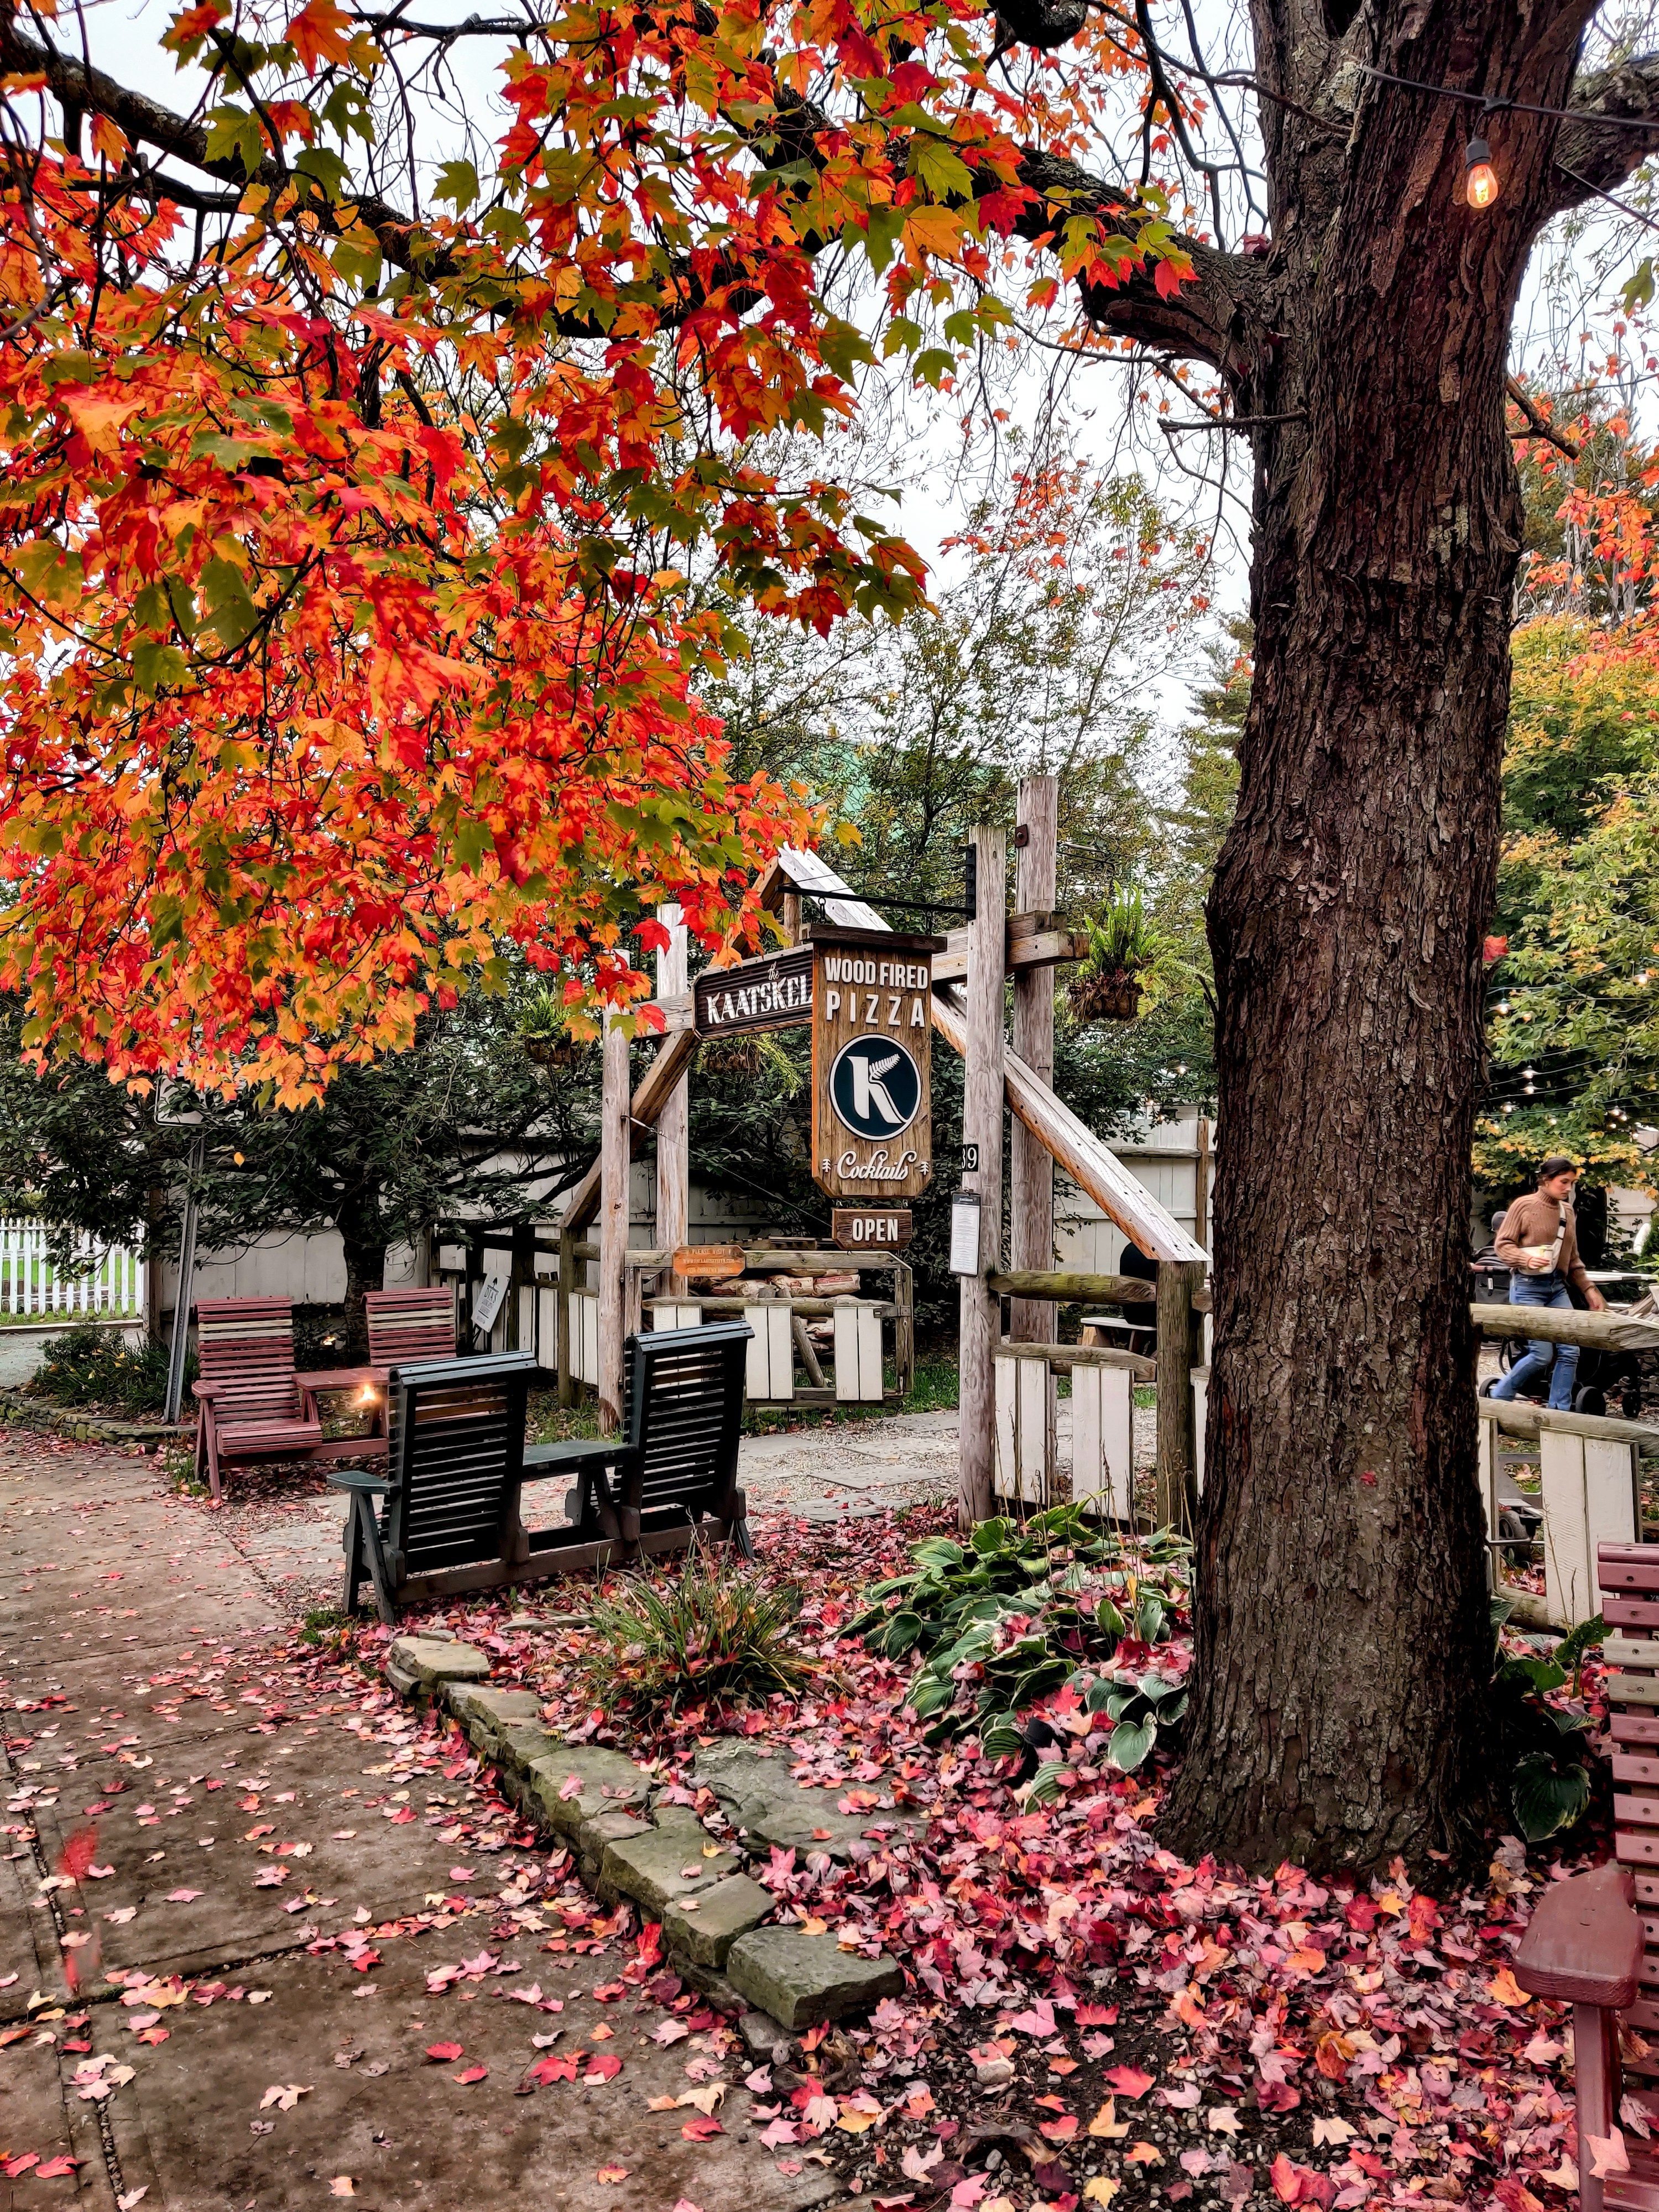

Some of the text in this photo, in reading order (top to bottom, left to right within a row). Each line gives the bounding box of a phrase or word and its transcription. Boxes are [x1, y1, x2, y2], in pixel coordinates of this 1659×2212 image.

[768, 961, 780, 980] the
[825, 957, 928, 989] WOOD FIRED
[826, 990, 925, 1027] PIZZA
[846, 1053, 908, 1124] K
[837, 1150, 917, 1180] Cocktails
[852, 1219, 898, 1241] OPEN
